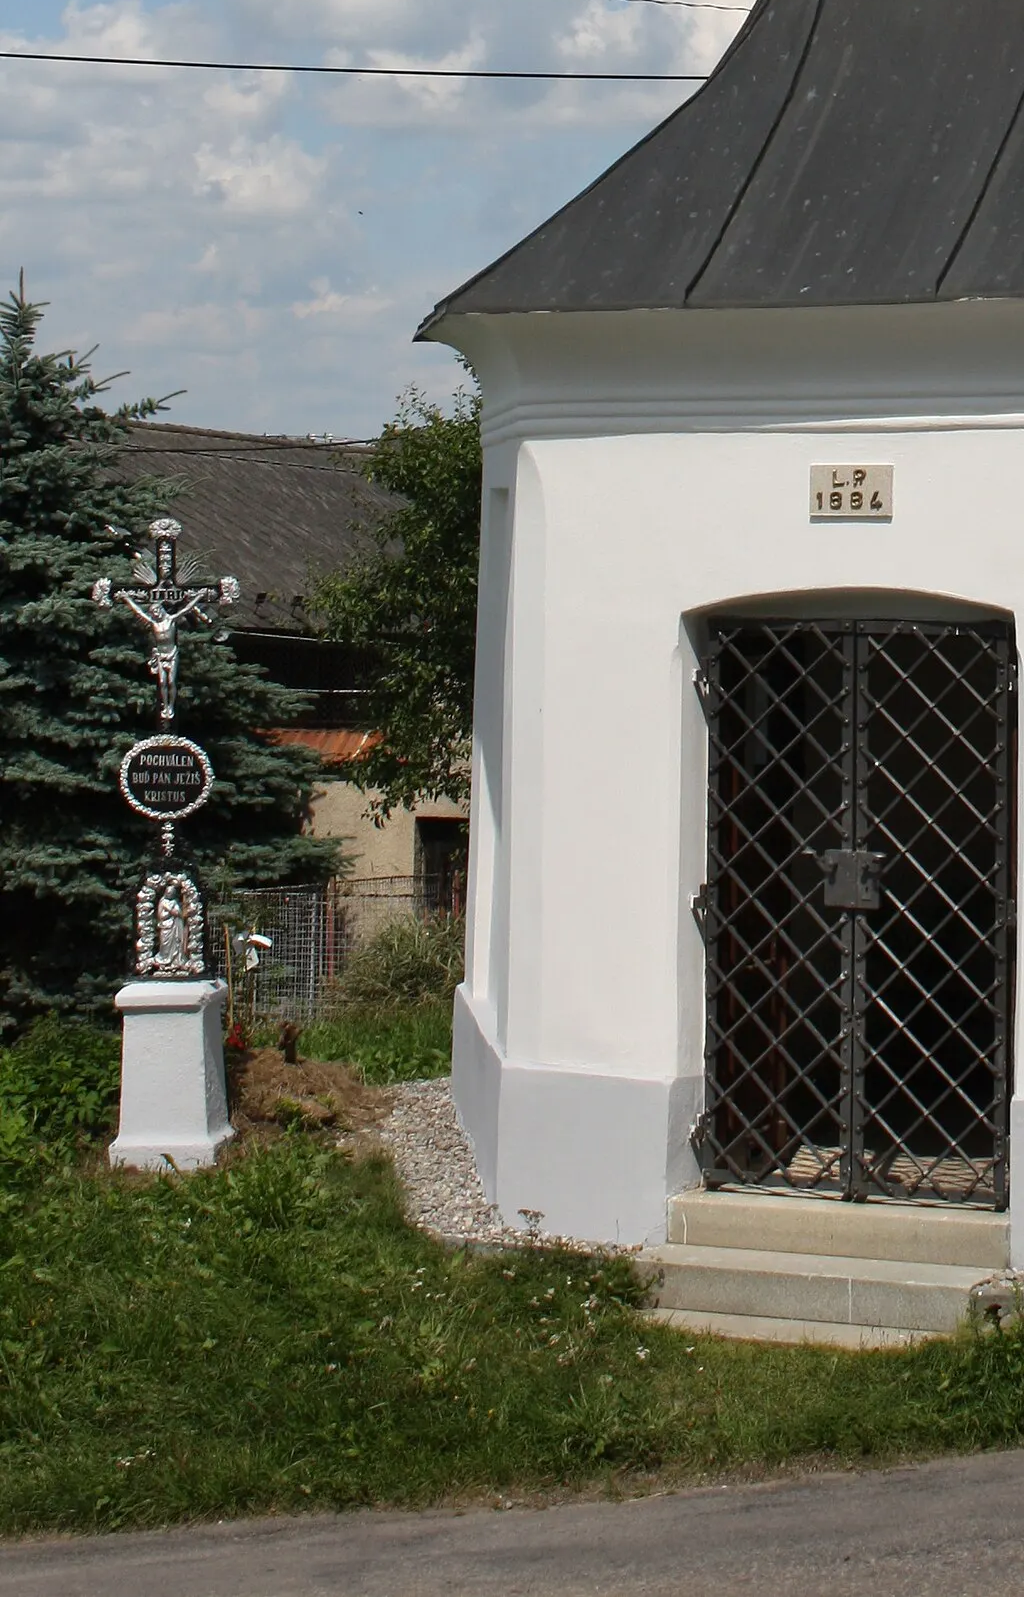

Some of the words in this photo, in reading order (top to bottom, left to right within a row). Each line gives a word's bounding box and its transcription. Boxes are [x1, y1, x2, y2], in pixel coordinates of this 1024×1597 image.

[816, 491, 883, 511] 1884
[140, 754, 194, 767] POCHVÁLEN
[144, 790, 186, 803] KRISTUS
